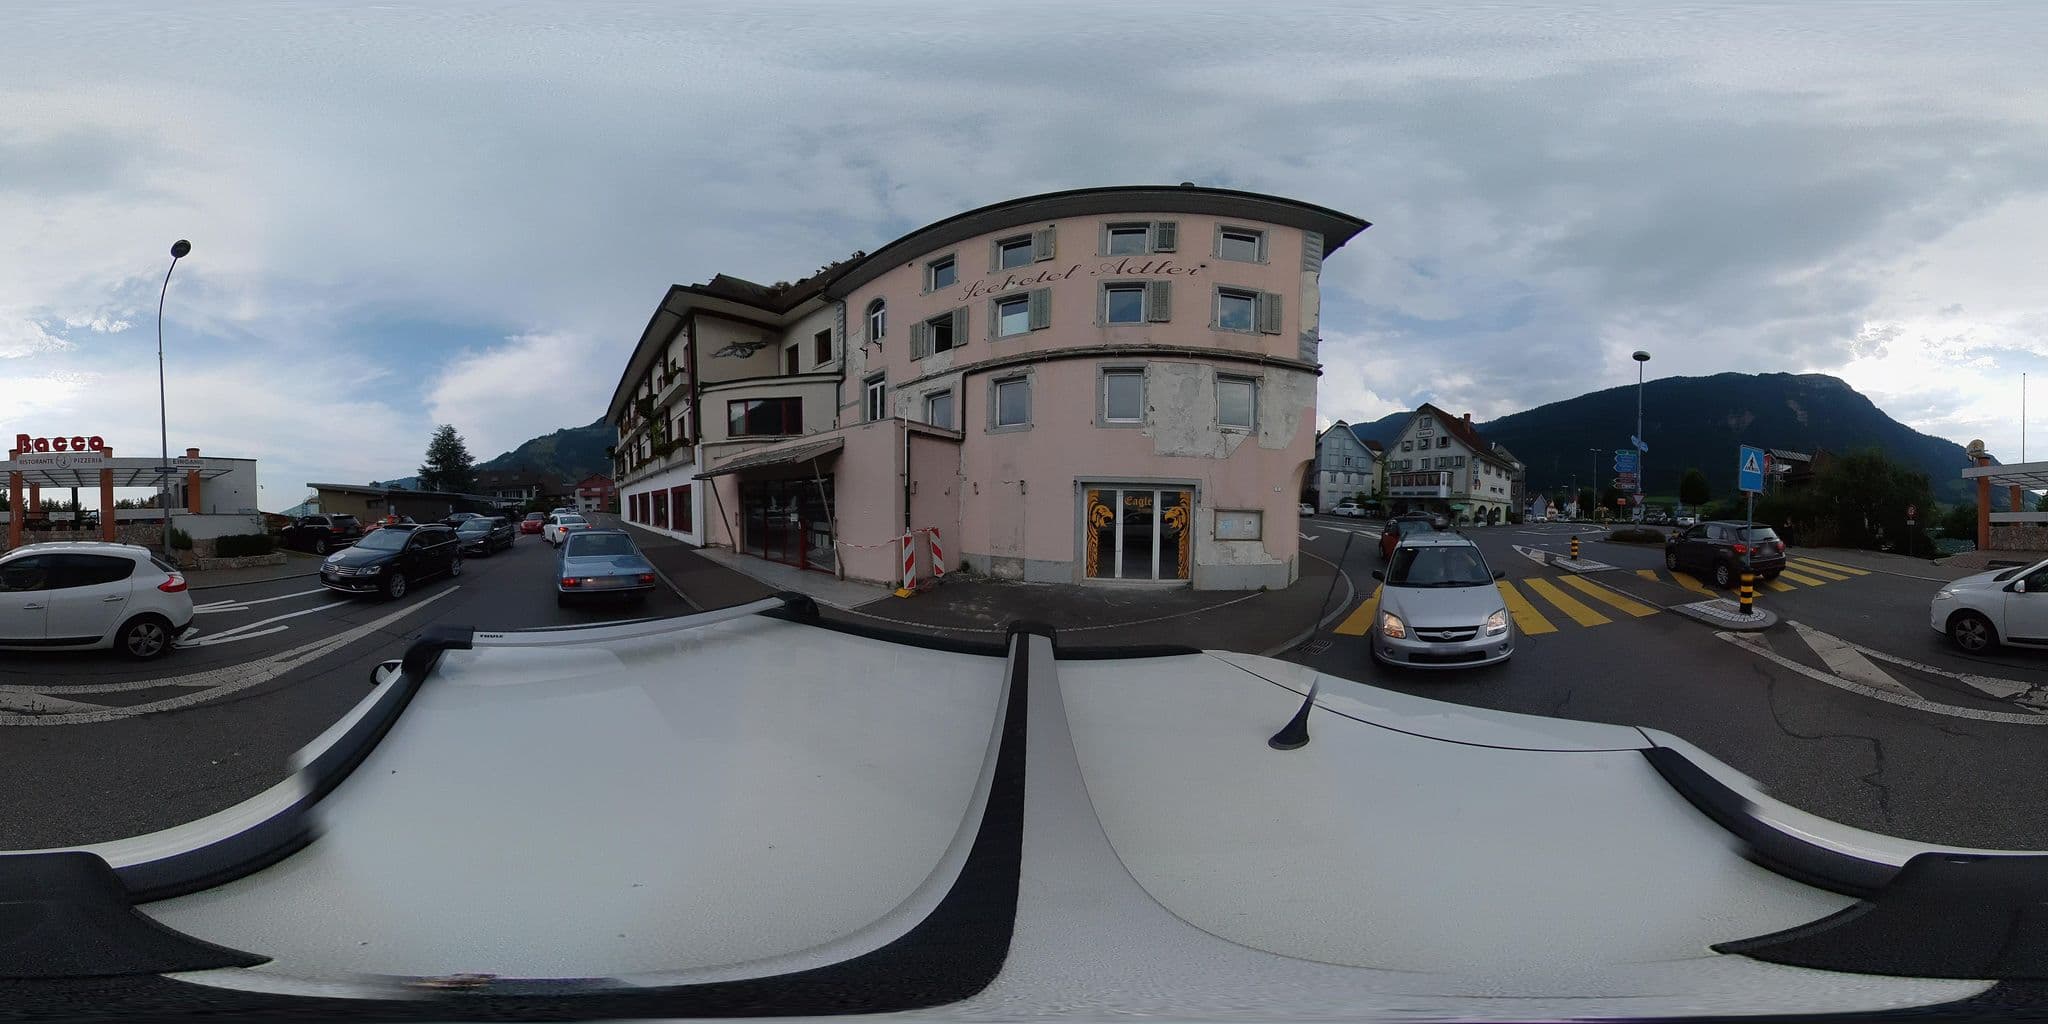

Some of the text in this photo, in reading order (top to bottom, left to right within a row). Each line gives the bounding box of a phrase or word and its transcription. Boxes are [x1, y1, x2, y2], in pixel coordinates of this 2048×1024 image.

[958, 257, 1205, 301] Seehotel Adler
[16, 434, 104, 453] Bacco
[19, 457, 54, 465] RISTORANTE
[1124, 495, 1153, 507] Eagle
